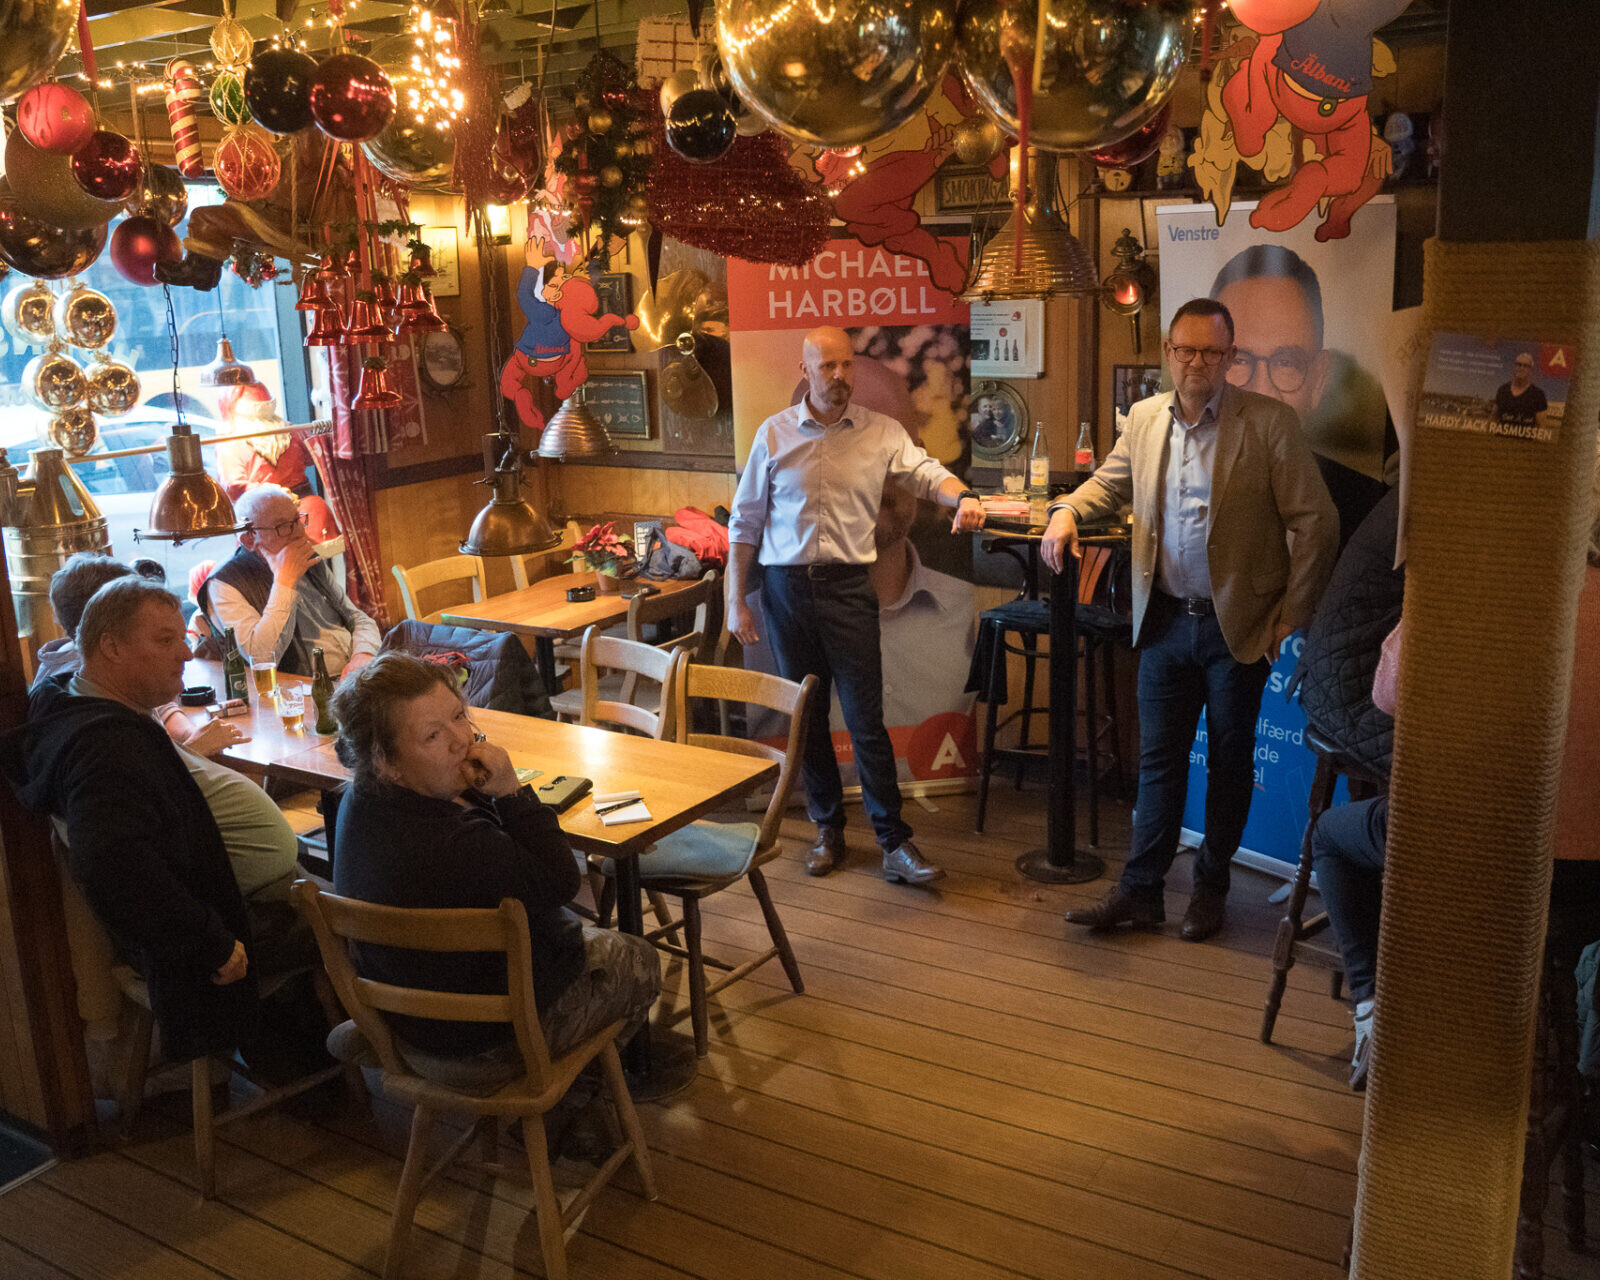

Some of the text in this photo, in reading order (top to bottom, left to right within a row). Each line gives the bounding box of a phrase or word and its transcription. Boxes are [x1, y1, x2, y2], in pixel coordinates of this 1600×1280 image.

[1168, 224, 1220, 241] Venstre
[769, 286, 936, 319] HARBØLL
[1548, 347, 1567, 368] A
[1424, 413, 1461, 429] HARDY
[1461, 418, 1488, 432] JACK
[1489, 423, 1553, 441] RASMUSSEN
[930, 731, 967, 772] A
